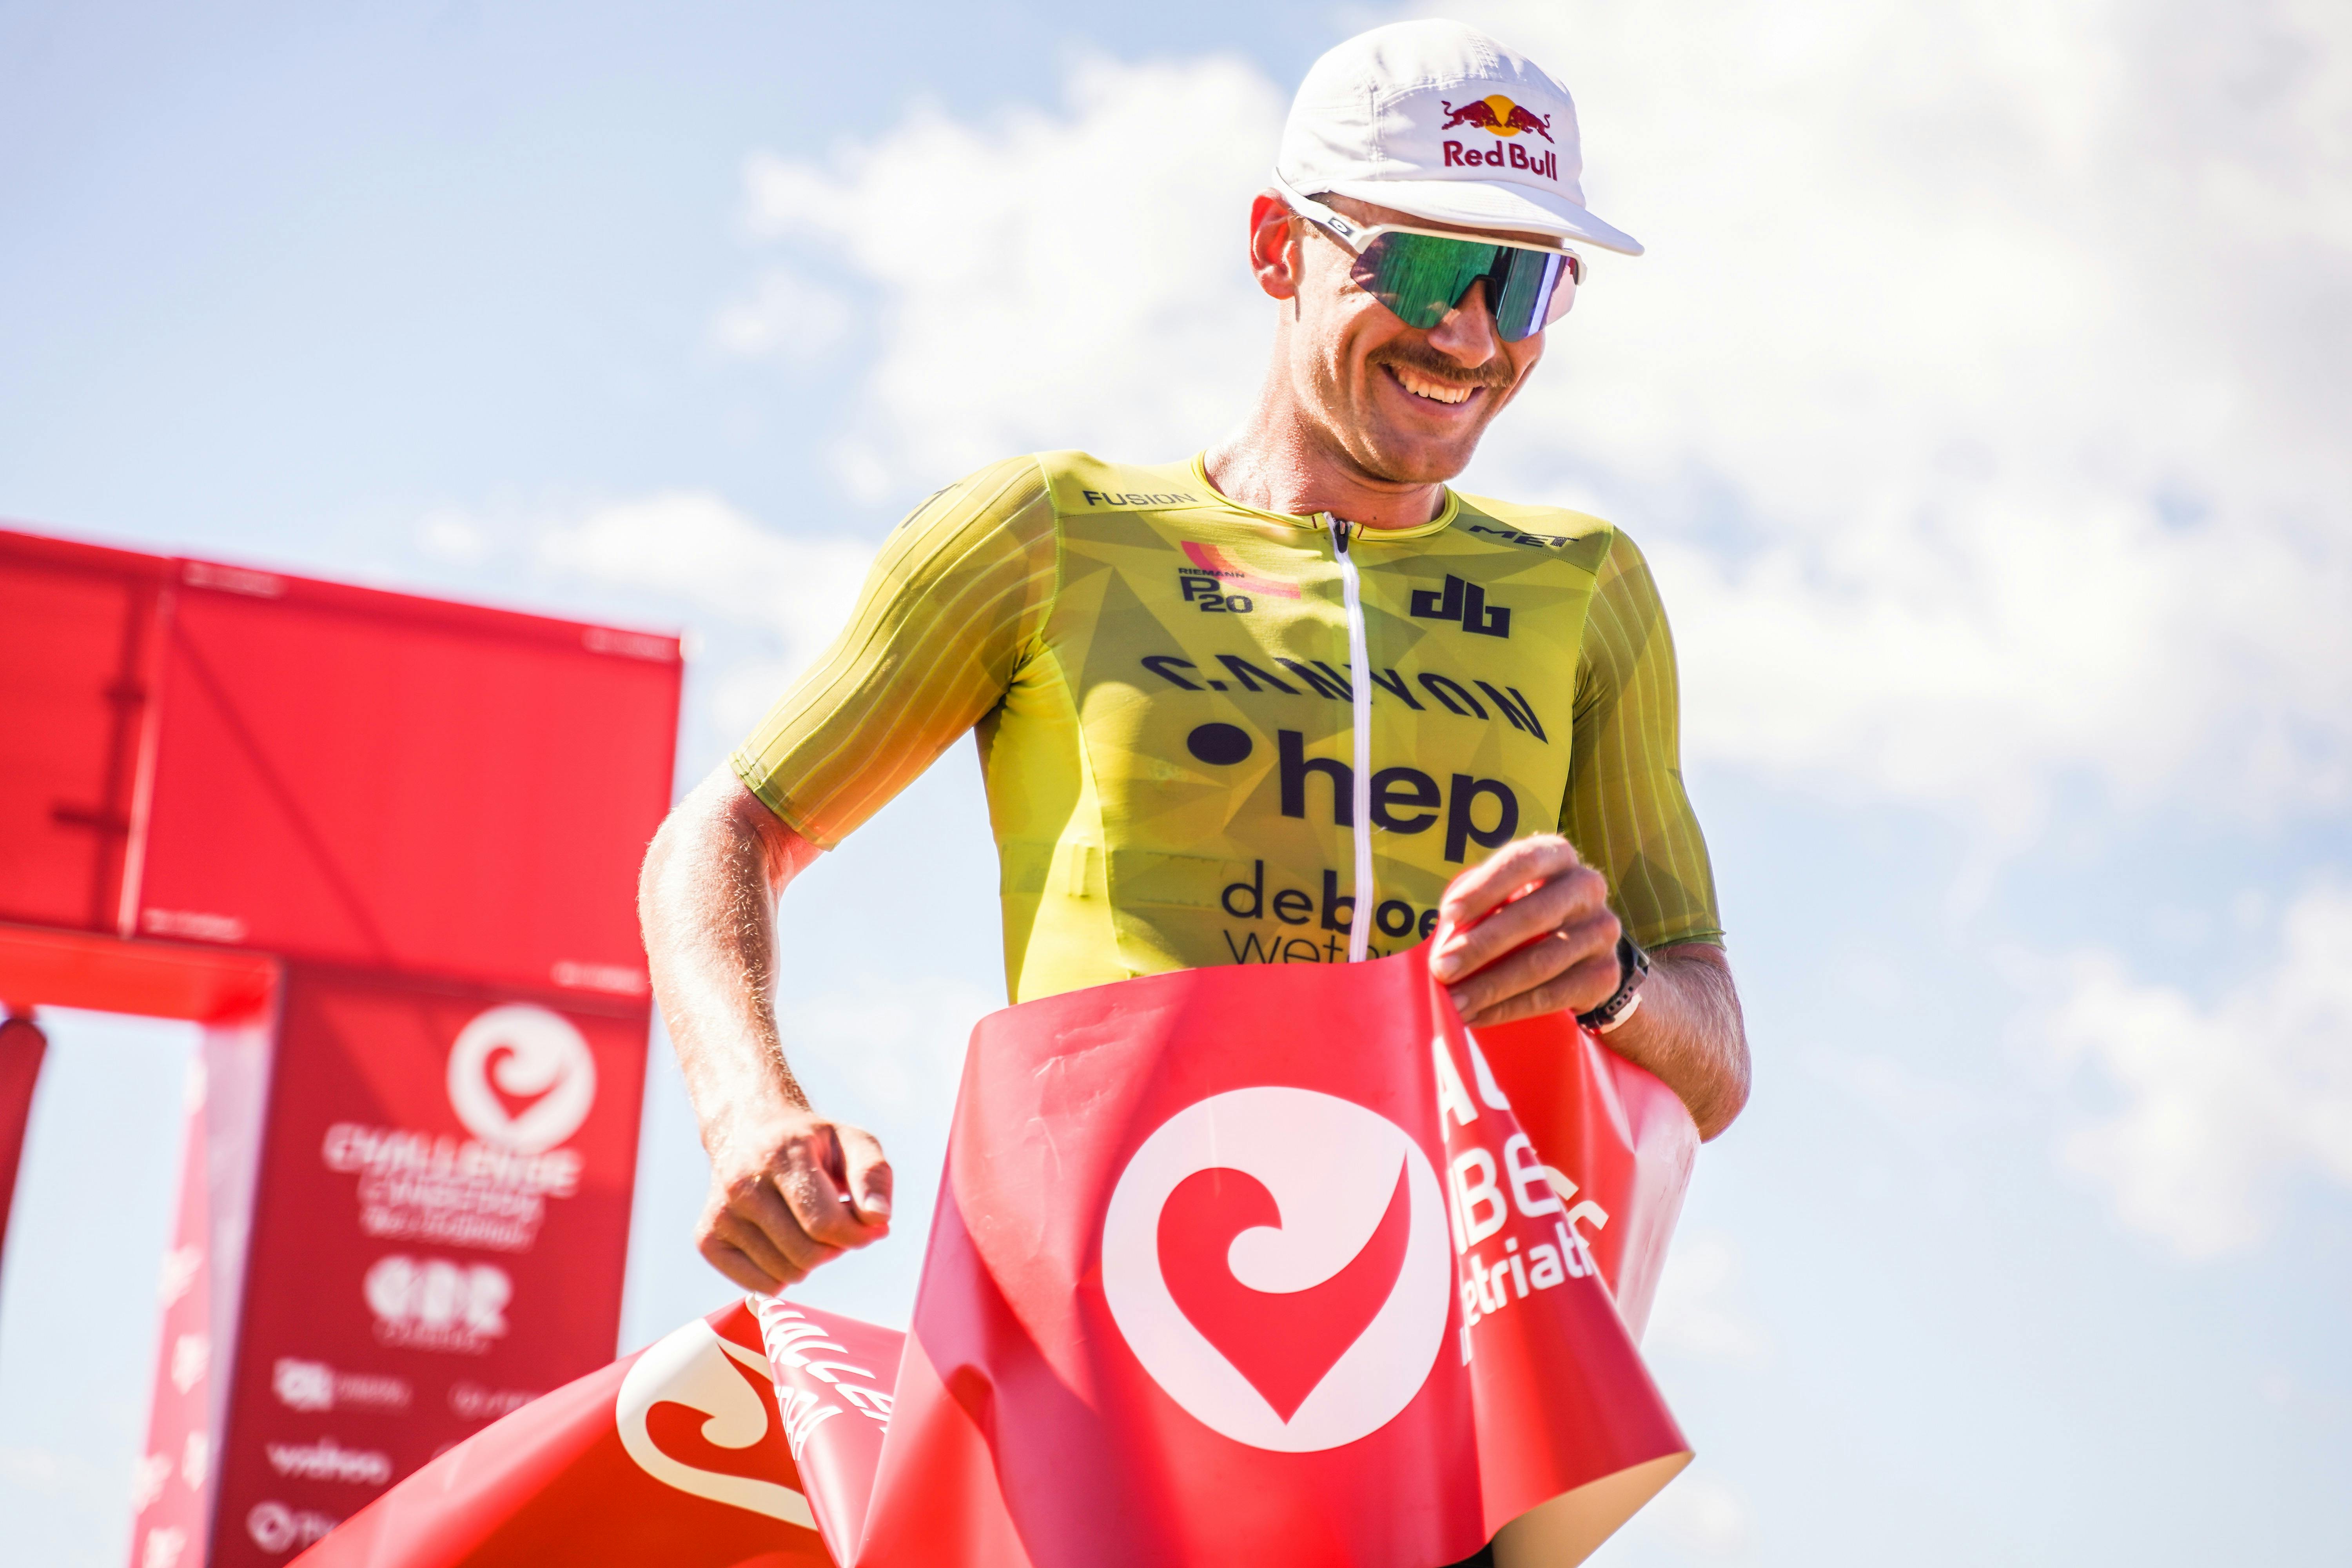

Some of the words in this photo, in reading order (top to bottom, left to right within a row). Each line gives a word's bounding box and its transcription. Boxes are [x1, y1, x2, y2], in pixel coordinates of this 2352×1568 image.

[1443, 140, 1505, 168] Red
[1508, 143, 1557, 181] Bull
[1082, 490, 1199, 506] FUSION
[1469, 525, 1579, 548] MET
[1178, 568, 1245, 578] RIEMANN
[1141, 655, 1549, 744] CANYON
[1278, 729, 1519, 864] hep
